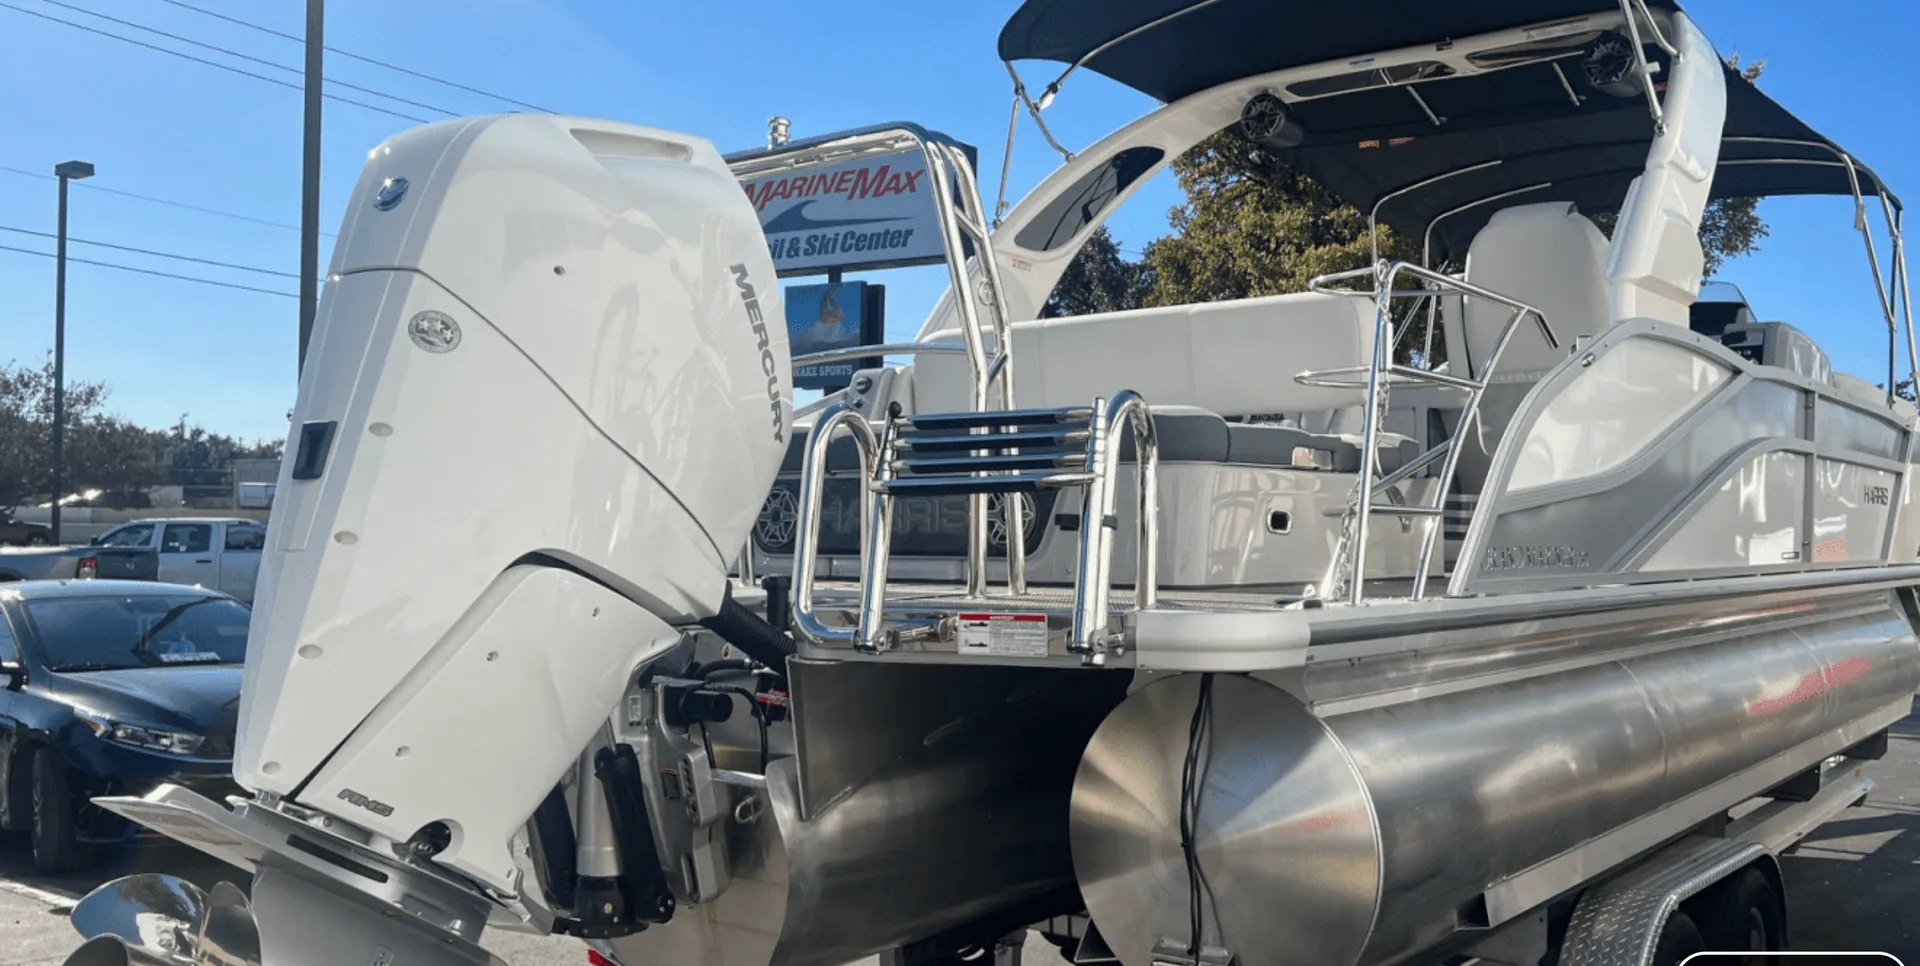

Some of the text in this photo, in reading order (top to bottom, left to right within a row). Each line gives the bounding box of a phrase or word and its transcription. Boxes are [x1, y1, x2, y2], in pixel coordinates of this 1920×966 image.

[769, 228, 914, 260] il & Ski Center
[730, 263, 784, 444] MERCURY
[819, 364, 853, 377] SPORTS
